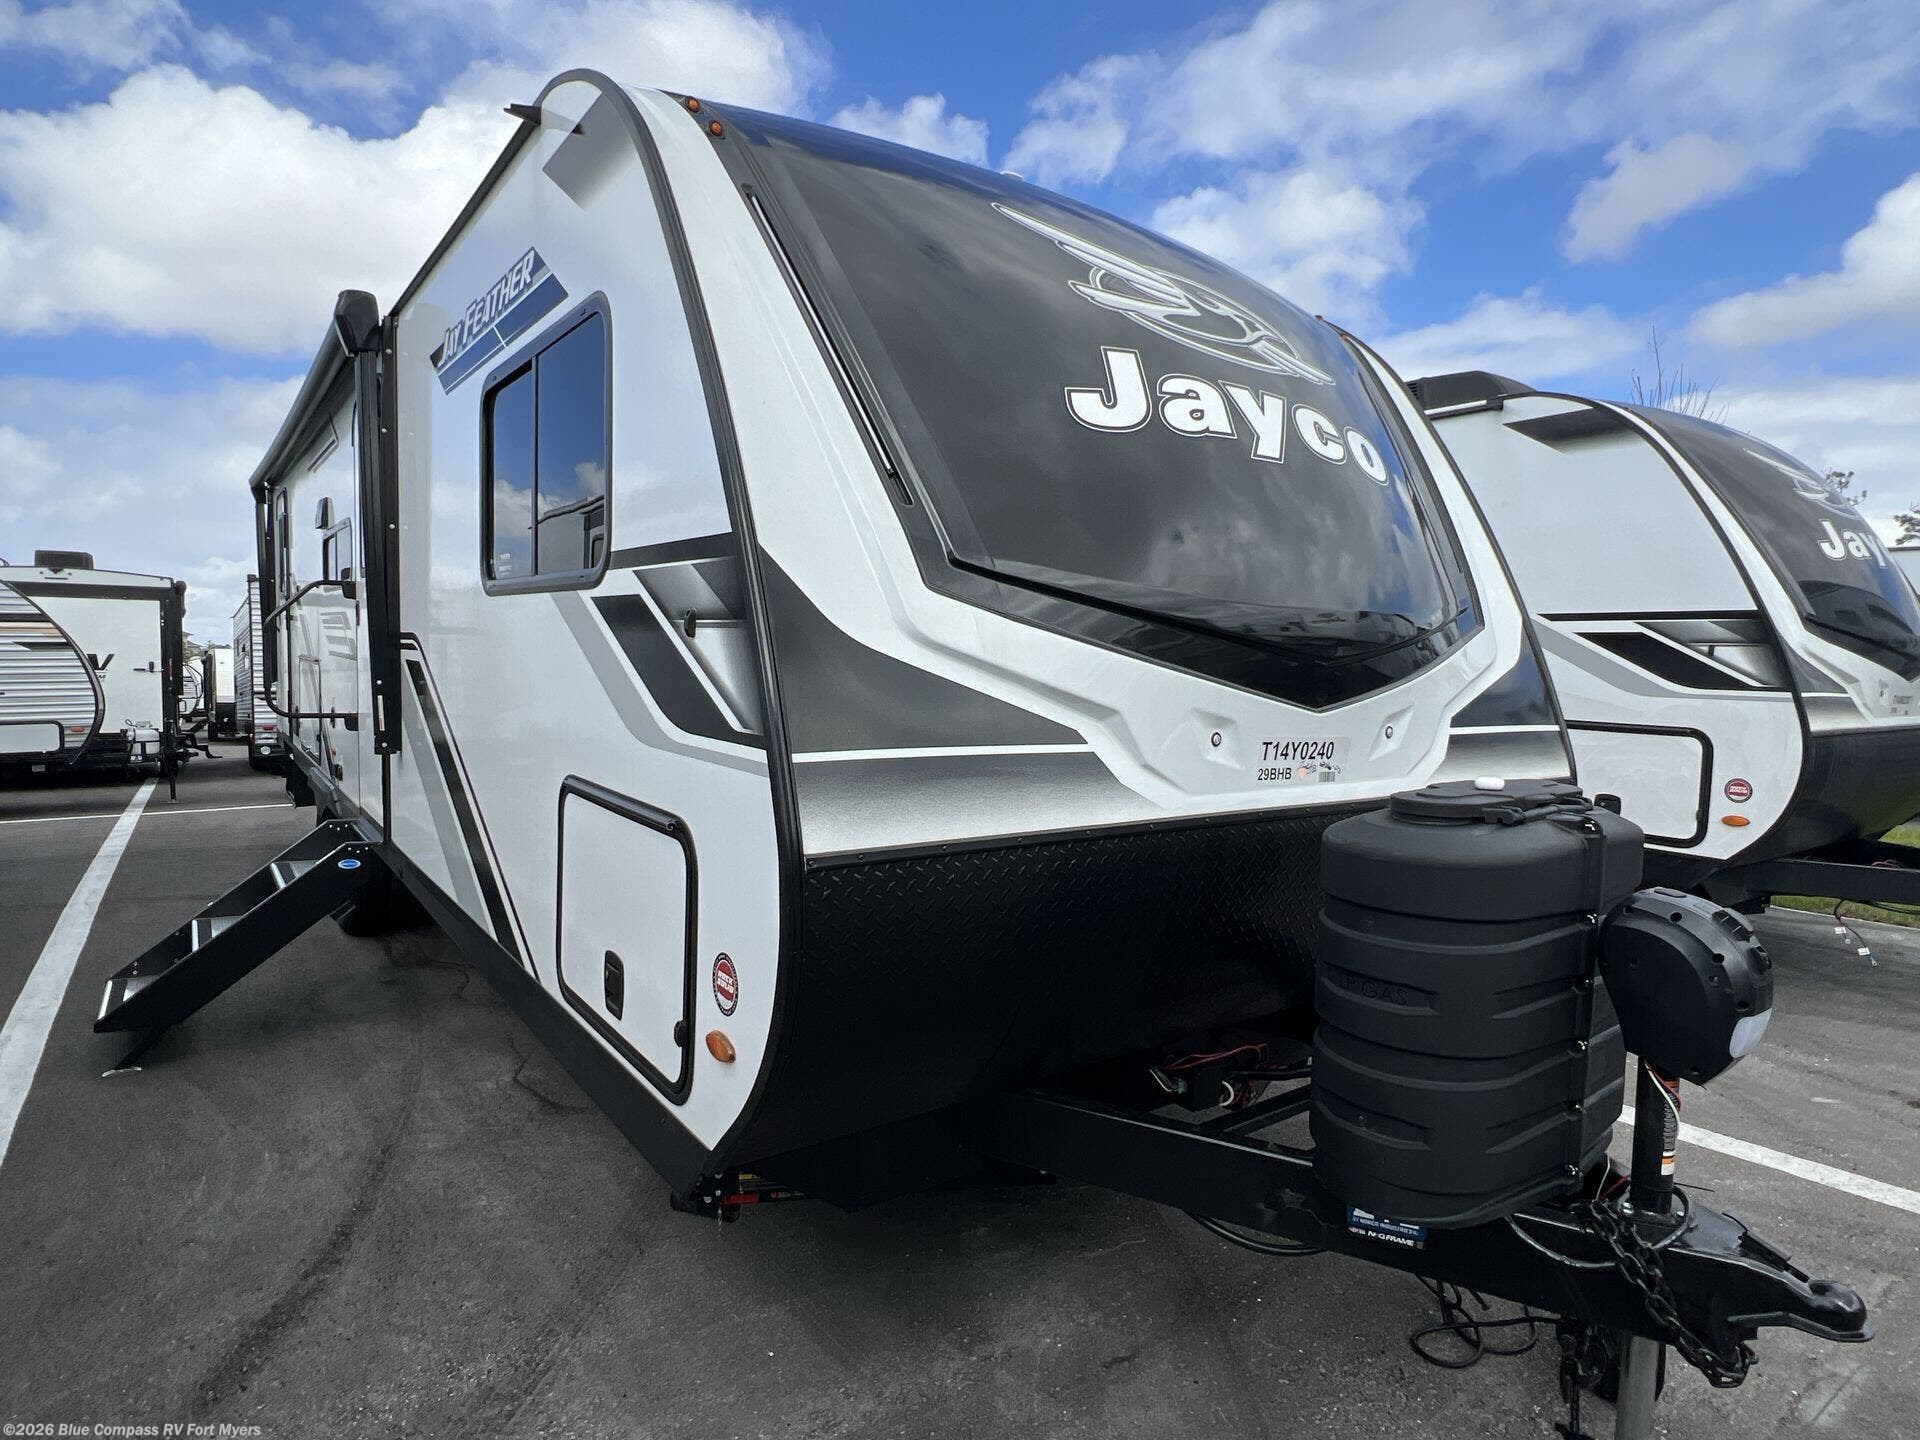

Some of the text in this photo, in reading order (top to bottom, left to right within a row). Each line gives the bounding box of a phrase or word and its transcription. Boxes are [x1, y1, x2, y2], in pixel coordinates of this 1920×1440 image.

[437, 250, 535, 367] JAY FEATHER
[1064, 345, 1390, 486] Jayco
[1262, 741, 1335, 761] T14Y0240
[1257, 767, 1292, 781] 29BHB
[1361, 980, 1408, 1006] GAS
